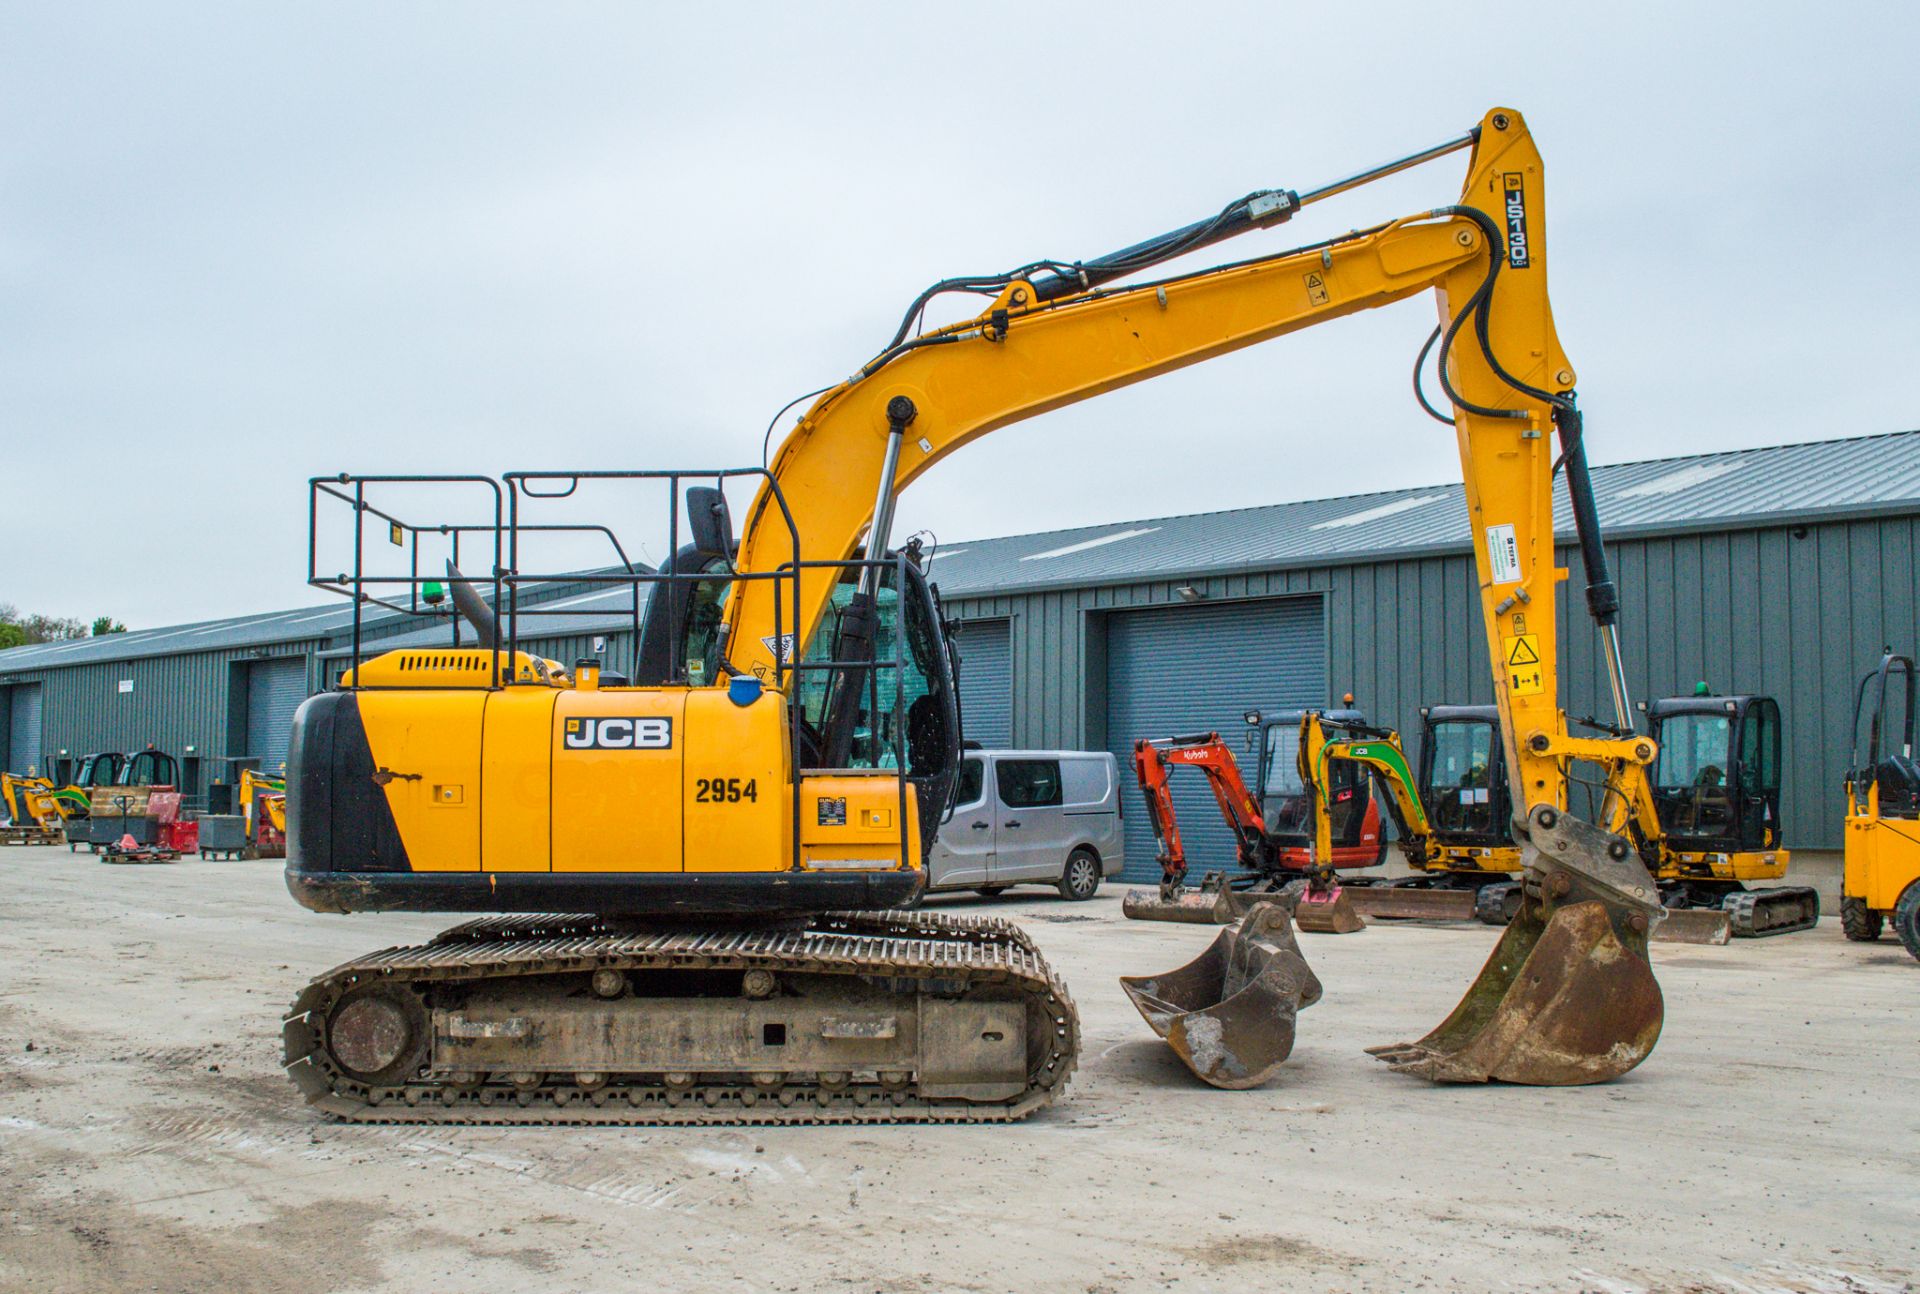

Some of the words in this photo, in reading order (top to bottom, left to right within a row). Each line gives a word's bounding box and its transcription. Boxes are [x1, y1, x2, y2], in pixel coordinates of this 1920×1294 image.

[1507, 190, 1527, 260] JS130
[566, 719, 670, 747] JCB
[1184, 749, 1208, 760] Kubota
[696, 778, 757, 803] 2954
